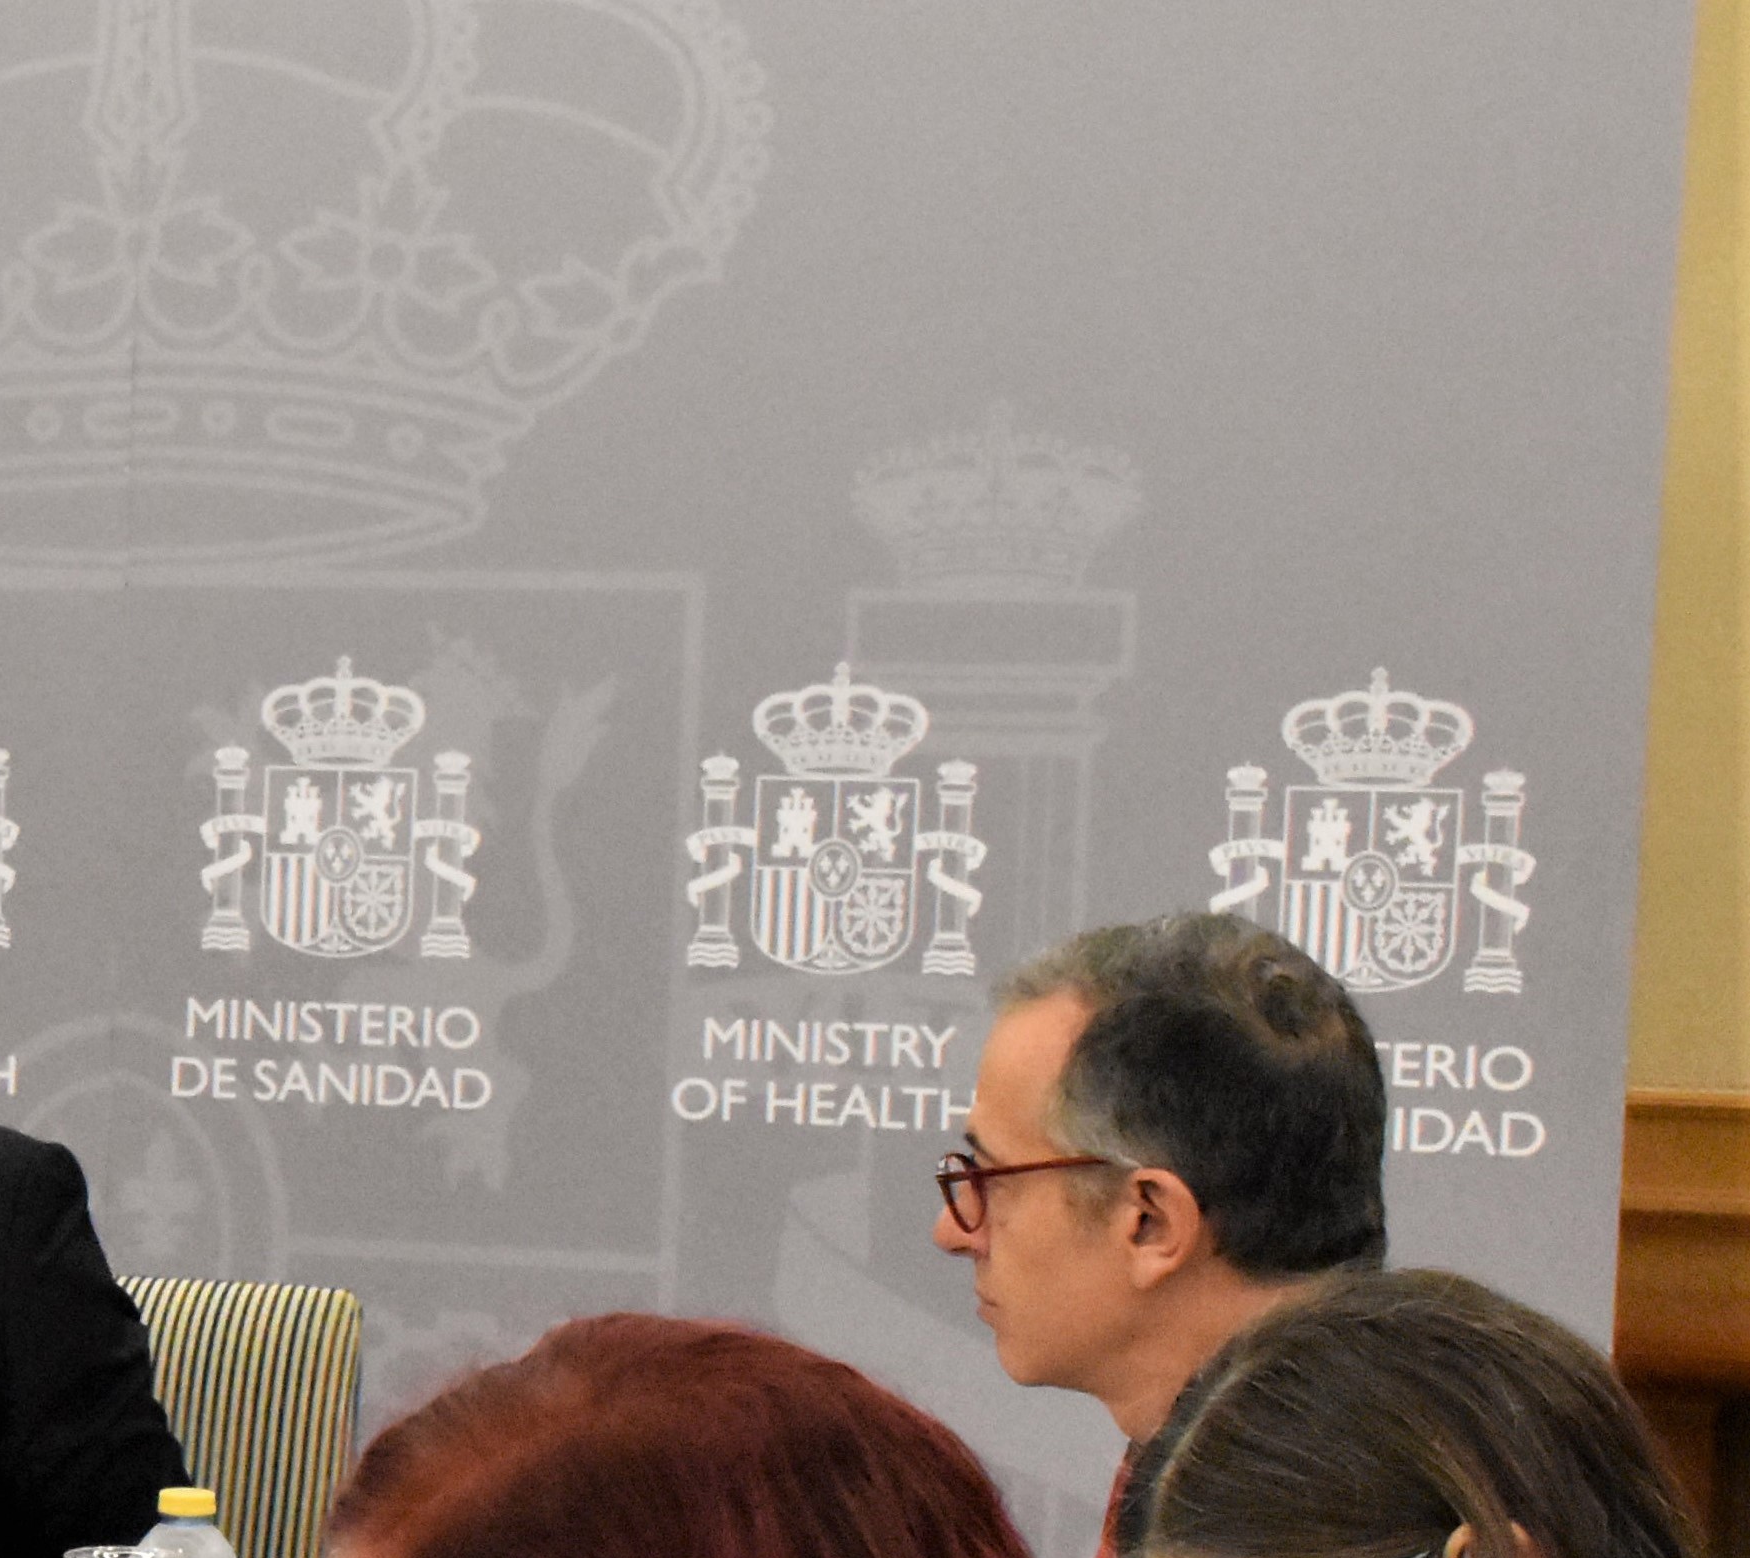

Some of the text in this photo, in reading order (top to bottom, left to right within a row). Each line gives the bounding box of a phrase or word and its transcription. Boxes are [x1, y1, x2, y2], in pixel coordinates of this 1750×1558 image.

[185, 997, 481, 1050] MINISTERIO
[703, 1017, 957, 1069] MINISTRY
[170, 1055, 493, 1110] DE SANIDAD
[671, 1077, 748, 1122] OF
[1391, 1106, 1546, 1158] IDAD
